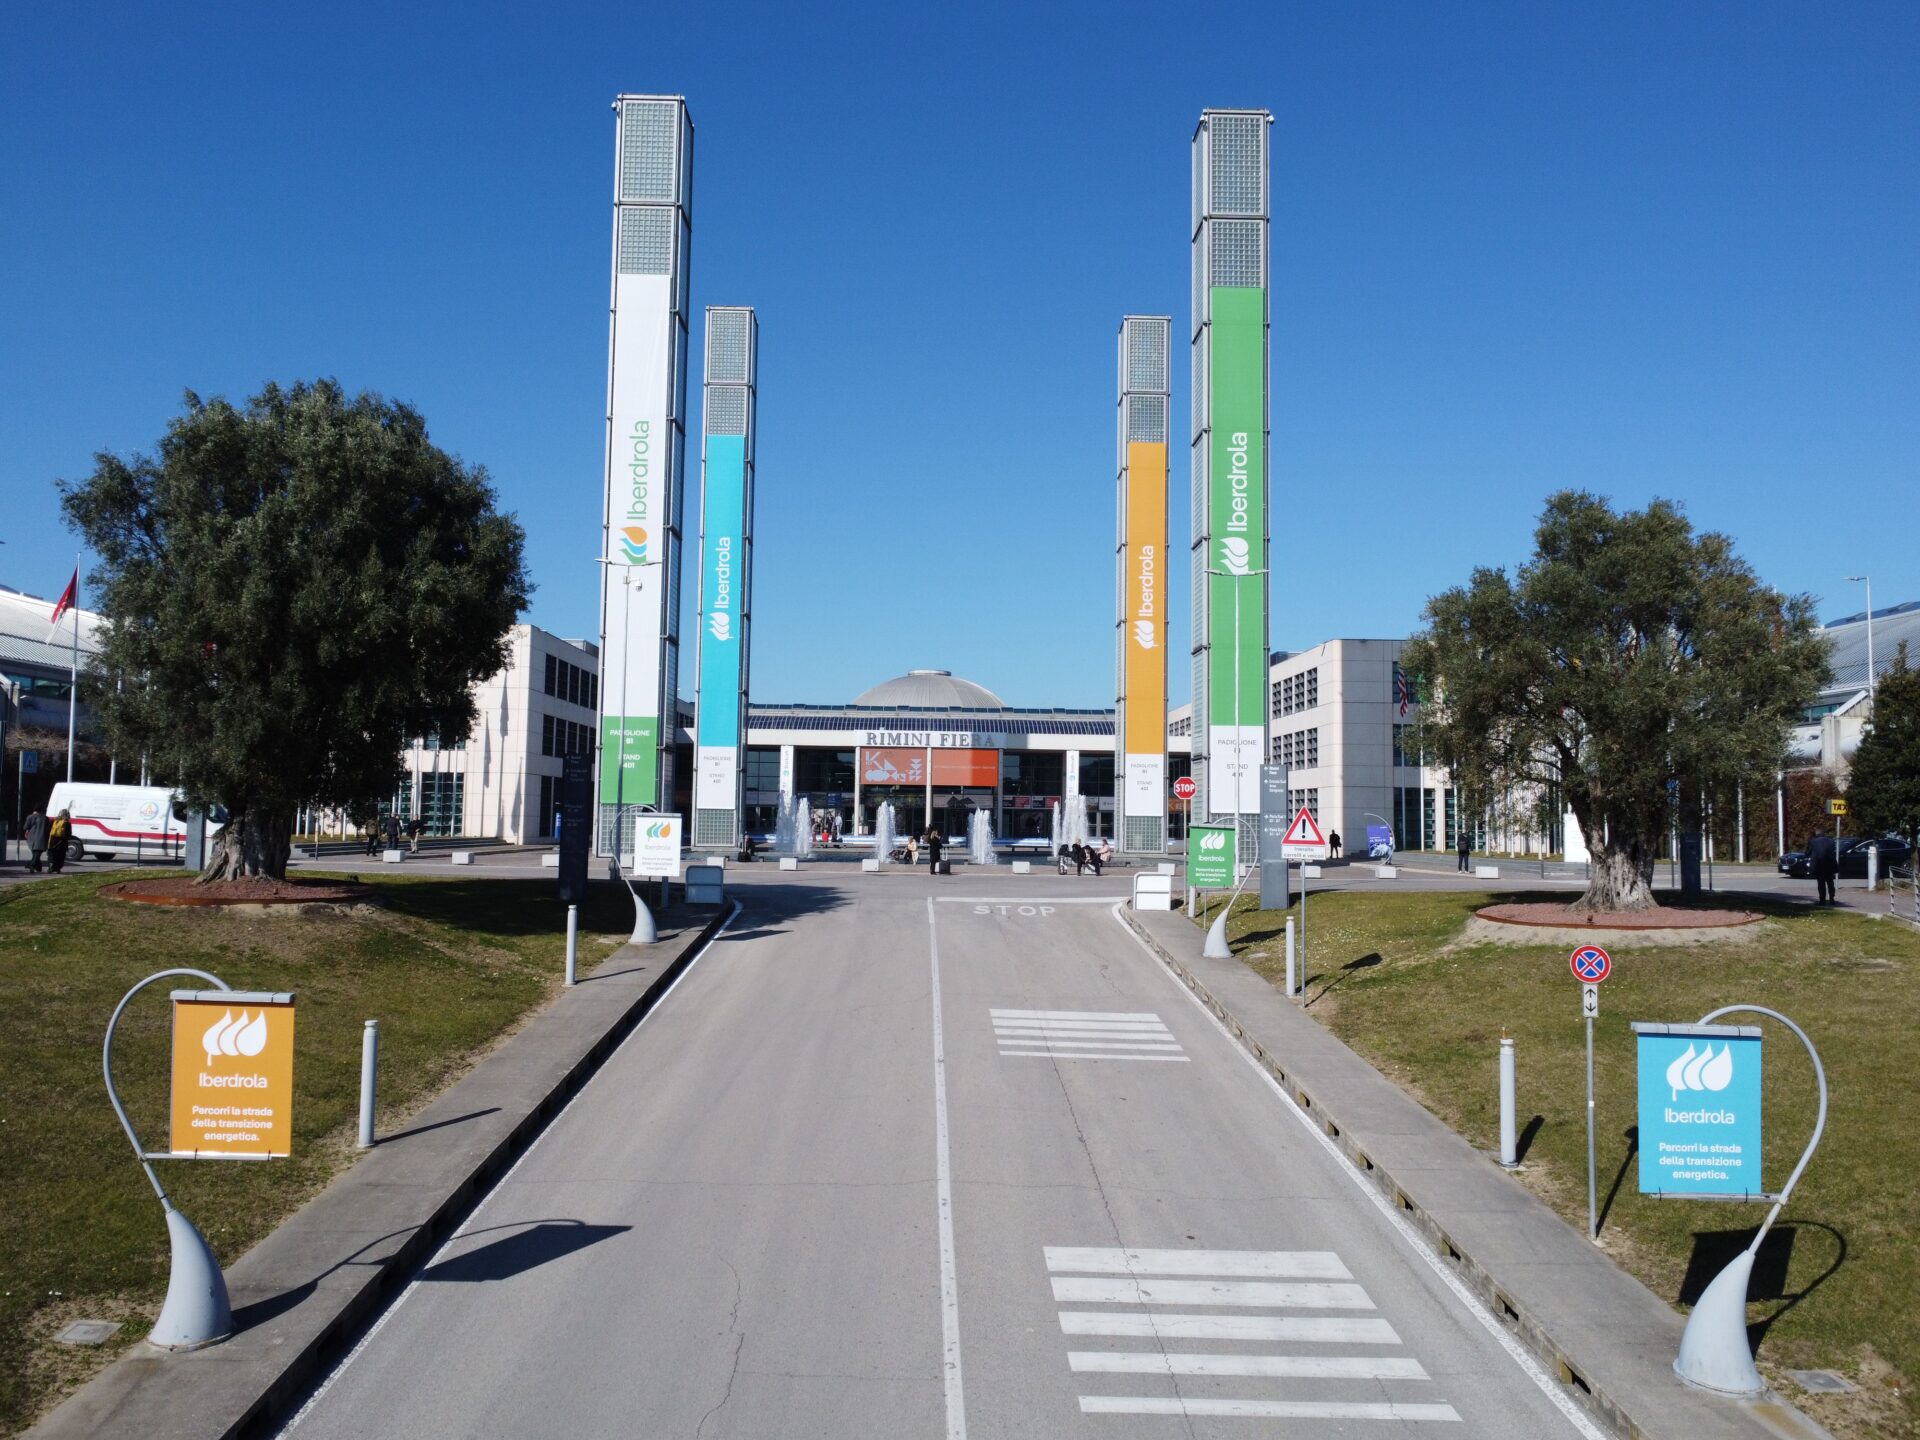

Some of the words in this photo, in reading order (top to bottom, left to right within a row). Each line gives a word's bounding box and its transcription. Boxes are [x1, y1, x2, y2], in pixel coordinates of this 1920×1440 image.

[627, 420, 650, 520] Iberdrola
[1227, 432, 1248, 531] Iberdrola
[714, 537, 731, 608] Iberdrola
[1138, 545, 1154, 616] Iberdrola
[866, 732, 930, 746] RIMINI
[940, 734, 994, 746] FIERA
[1175, 784, 1195, 792] STOP
[972, 905, 1056, 917] STOP
[199, 1073, 268, 1088] Iberdrola
[192, 1106, 230, 1116] Percorri
[232, 1106, 240, 1116] la
[242, 1107, 272, 1116] strada
[1665, 1108, 1735, 1124] Iberdrola
[192, 1119, 216, 1128] della
[219, 1119, 272, 1129] transizione
[204, 1131, 260, 1142] energetica.
[1659, 1143, 1698, 1152] Percorri
[1700, 1143, 1708, 1153] la
[1710, 1144, 1742, 1153] strada
[1659, 1157, 1684, 1166] della
[1686, 1157, 1742, 1166] transizione
[1672, 1169, 1729, 1181] energetica.
